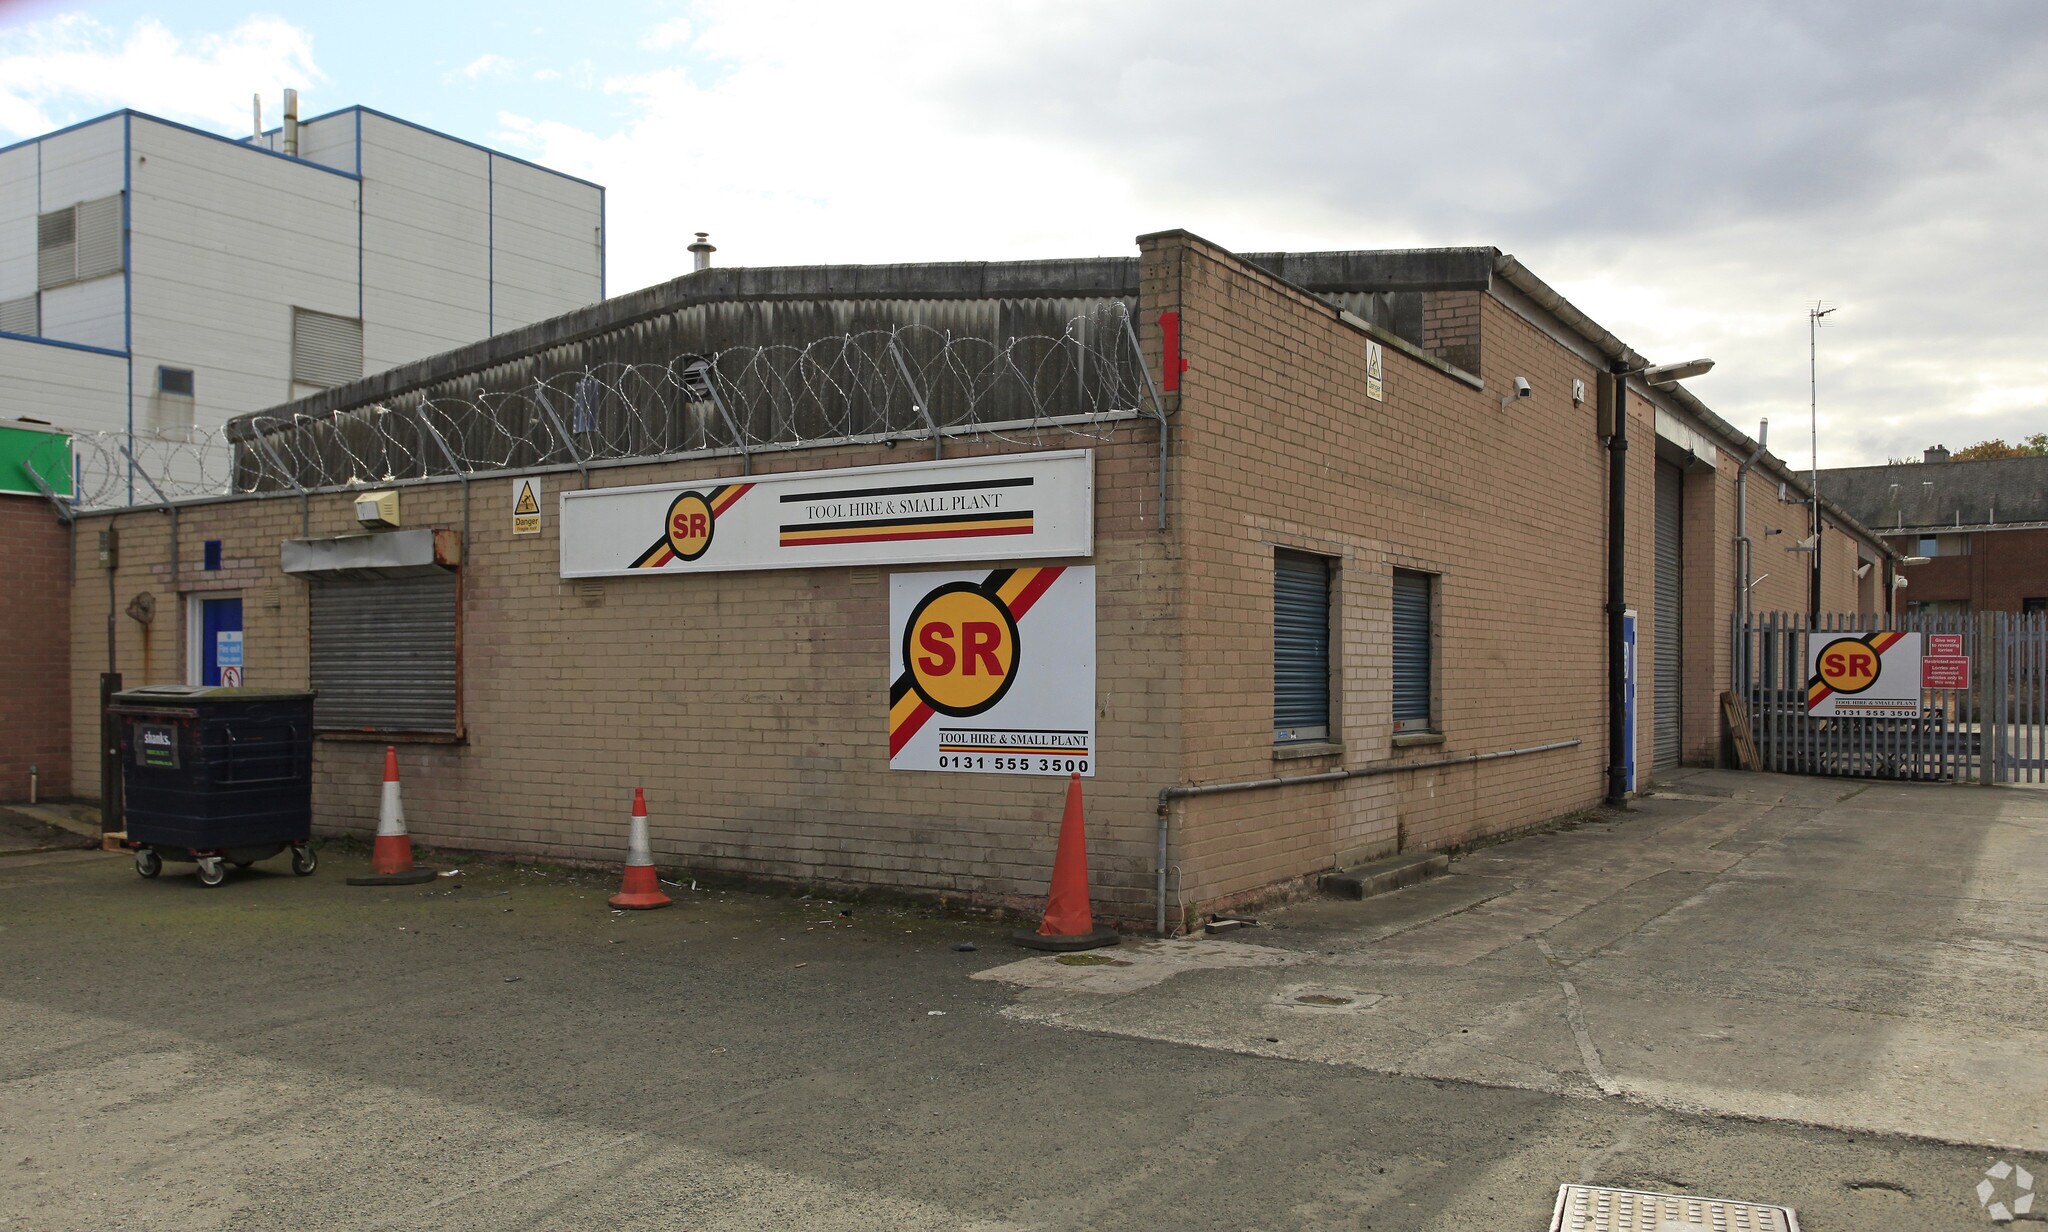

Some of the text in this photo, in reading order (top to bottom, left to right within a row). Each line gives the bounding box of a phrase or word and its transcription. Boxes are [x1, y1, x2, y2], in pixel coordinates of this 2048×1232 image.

[806, 493, 1003, 519] TOOL HIRE & SMALL PLANT
[515, 518, 538, 526] Danger
[672, 513, 708, 540] SR
[918, 621, 1005, 677] SR
[1824, 654, 1873, 678] SR
[939, 732, 1089, 746] TOOL HIRE & SMALL PLANT
[939, 755, 1089, 772] 0131 555 3500
